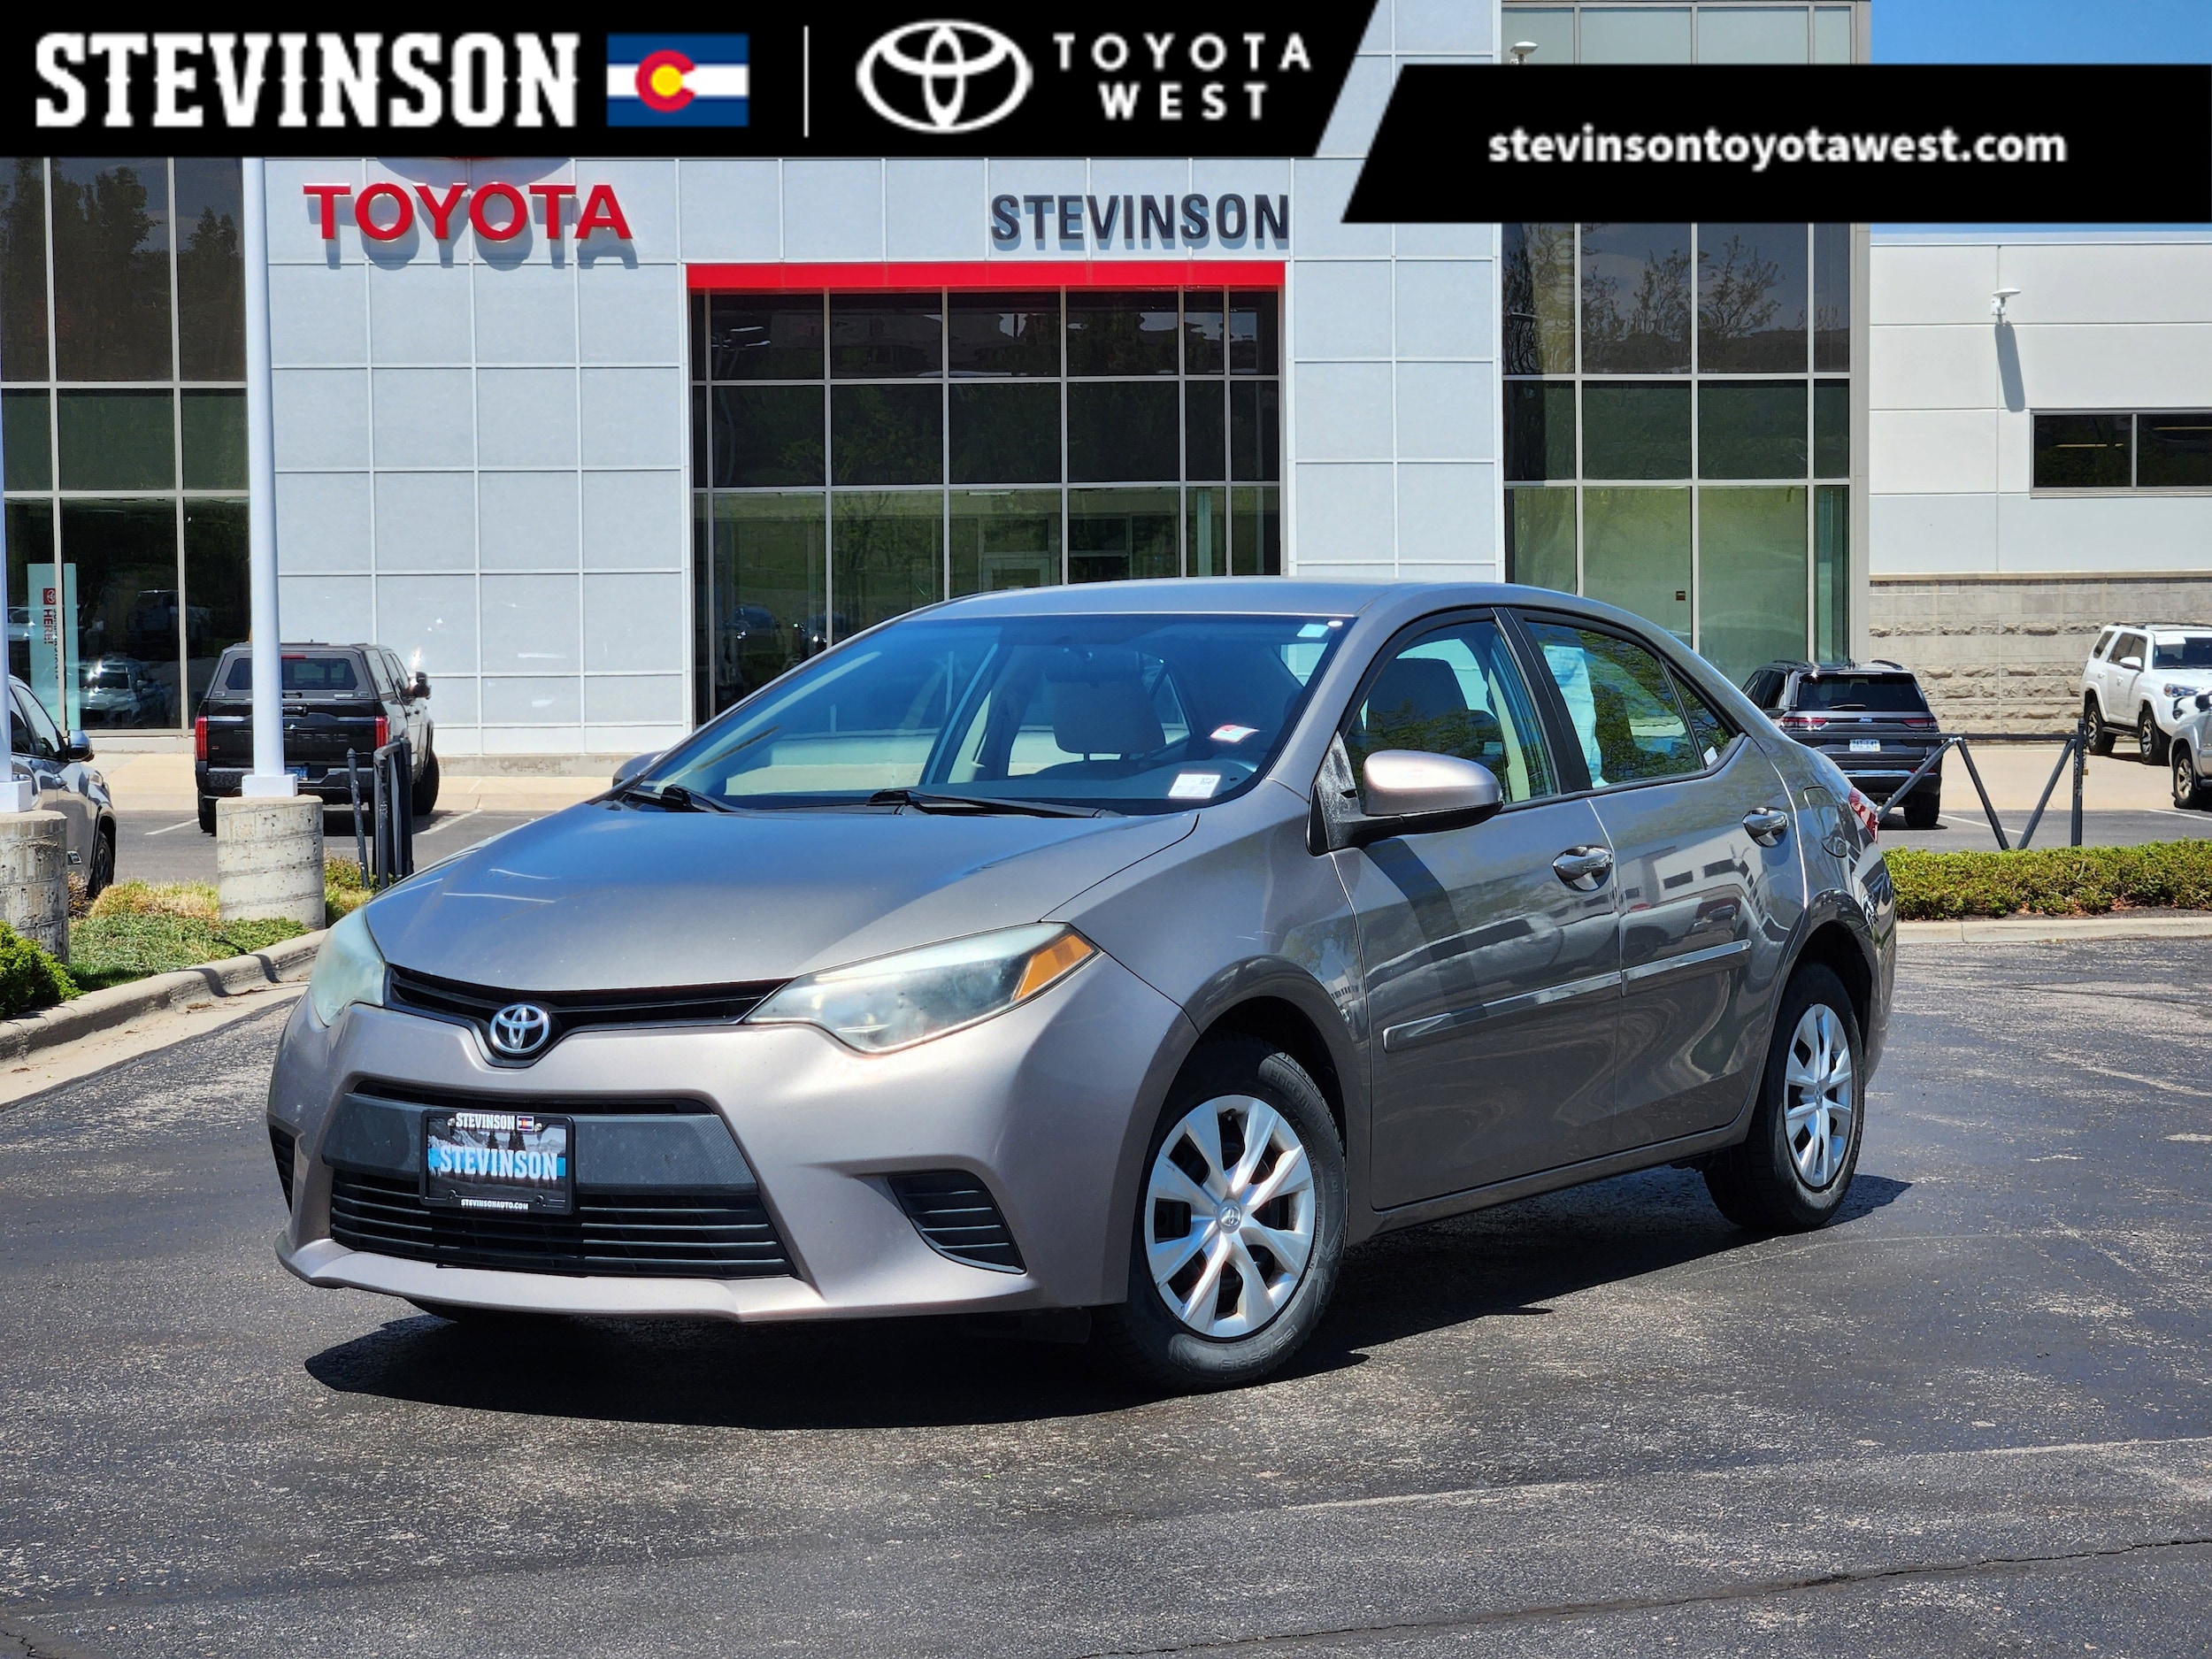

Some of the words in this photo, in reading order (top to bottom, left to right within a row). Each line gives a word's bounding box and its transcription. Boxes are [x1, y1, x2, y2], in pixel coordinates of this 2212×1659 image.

[303, 182, 634, 243] TOYOTA
[990, 193, 1290, 242] STEVINSON
[455, 1112, 516, 1131] STEVINSON
[440, 1144, 558, 1181] STEVINSON
